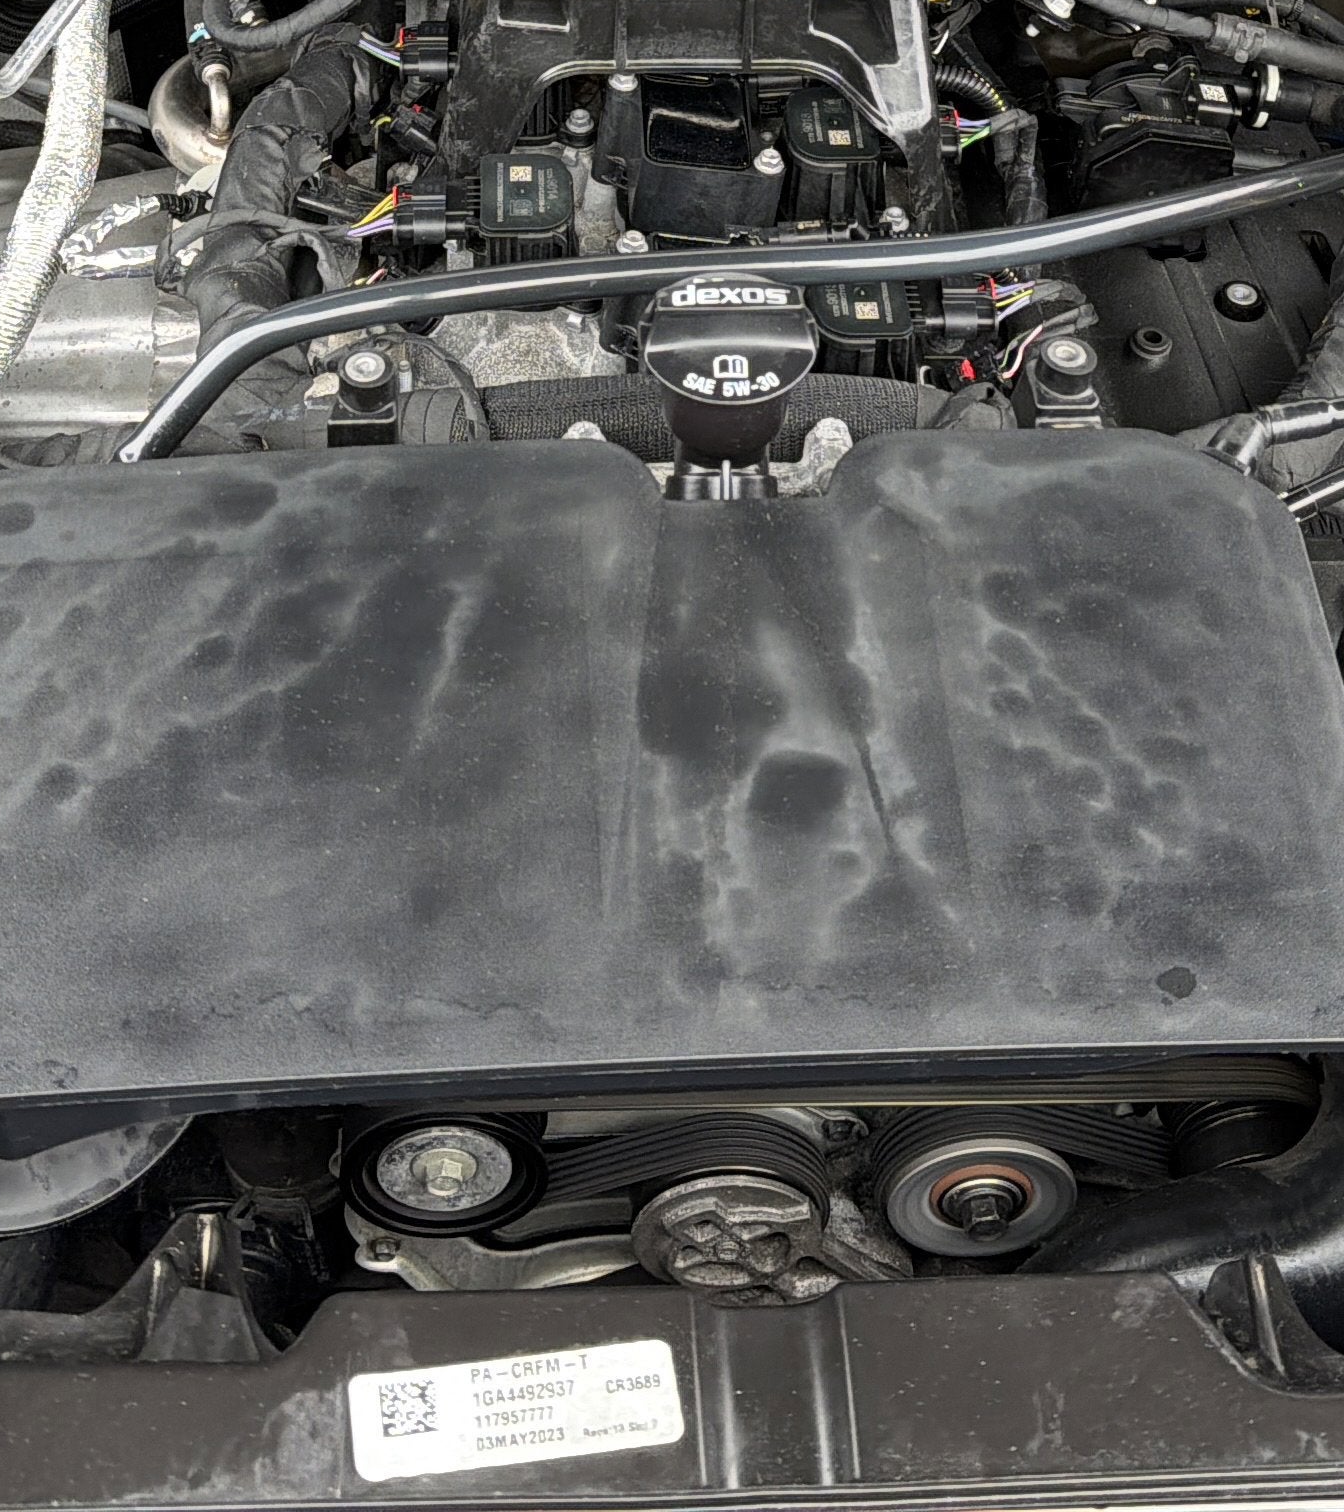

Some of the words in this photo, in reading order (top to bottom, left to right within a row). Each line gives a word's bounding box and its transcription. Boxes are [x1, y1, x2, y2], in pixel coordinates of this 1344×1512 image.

[671, 284, 791, 308] dexos
[682, 372, 715, 396] SAE
[722, 371, 780, 398] 5W-30
[476, 1427, 566, 1452] 03MAY2023
